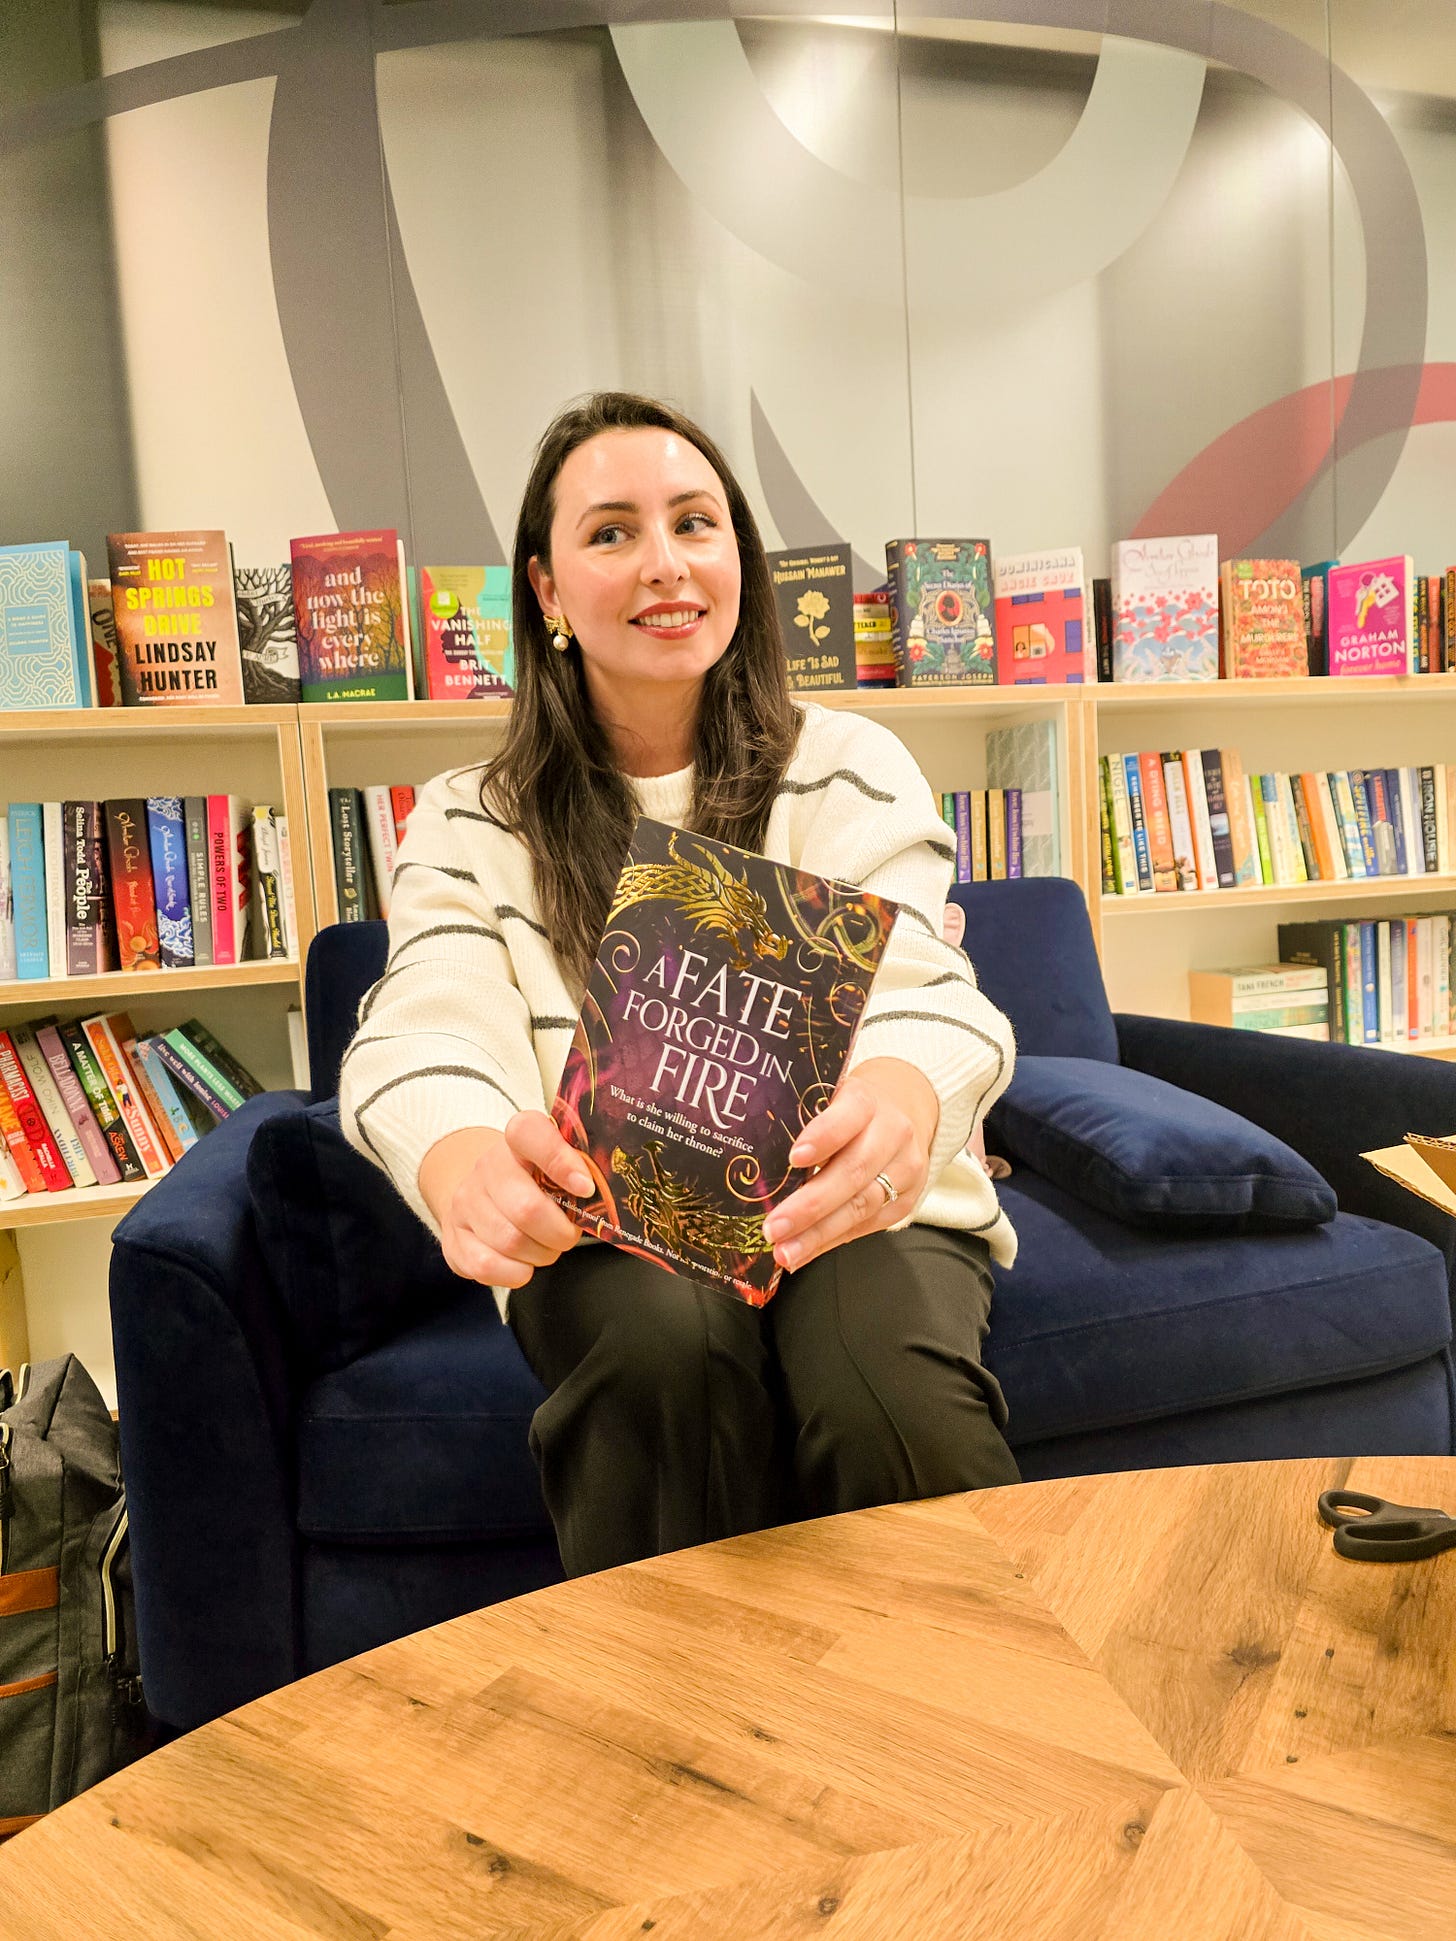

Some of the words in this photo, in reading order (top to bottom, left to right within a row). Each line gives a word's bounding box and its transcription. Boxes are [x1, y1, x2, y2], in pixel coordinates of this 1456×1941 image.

[147, 558, 185, 580] HOT
[324, 566, 361, 587] and
[773, 569, 806, 584] HUSSAIN
[806, 564, 846, 579] MANAWER
[125, 585, 215, 610] SPRINGS
[307, 593, 343, 610] now
[351, 586, 385, 606] the
[143, 613, 202, 637] DRIVE
[312, 609, 358, 634] light
[364, 608, 381, 625] is
[431, 618, 513, 632] VANISHING
[135, 641, 216, 664] LINDSAY
[321, 632, 372, 652] every
[454, 634, 492, 646] HALF
[1335, 640, 1406, 663] NORTON
[1340, 629, 1399, 648] GRAHAM
[318, 650, 380, 669] where
[460, 659, 490, 671] BRIT
[787, 659, 806, 672] LIFE
[821, 654, 839, 669] SAD
[140, 669, 217, 692] HUNTER
[342, 688, 376, 699] MACRAE
[444, 674, 507, 687] BENNETT
[796, 672, 844, 687] BEAUTIFUL
[1147, 759, 1157, 768] A
[1111, 761, 1126, 806] NIGEL
[1149, 770, 1162, 807] DYING
[1422, 780, 1434, 813] IRON
[75, 807, 85, 838] Selina
[340, 805, 351, 828] Lost
[380, 813, 392, 848] PERFECT
[1154, 810, 1167, 845] BREED
[15, 818, 34, 871] LEIGH
[1423, 814, 1437, 861] HOUSE
[76, 840, 87, 864] Todd
[213, 832, 226, 873] POWERS
[342, 831, 357, 884] Storyteller
[196, 852, 206, 888] SIMPLE
[215, 877, 227, 888] OF
[73, 867, 92, 920] People
[199, 891, 208, 923] RULES
[217, 891, 227, 912] TWO
[20, 876, 39, 949] FERMOR
[643, 955, 666, 989] A
[669, 949, 802, 1040] FATE
[622, 989, 760, 1066] FORGED
[760, 1052, 793, 1084] IN
[0, 1049, 30, 1102] PHARMACIST
[27, 1054, 48, 1084] WOLF
[49, 1052, 86, 1113] BELLADONNA
[72, 1042, 82, 1051] A
[77, 1050, 98, 1090] MATTER
[92, 1086, 104, 1101] OF
[98, 1100, 114, 1124] TIME
[169, 1055, 183, 1070] well
[181, 1068, 195, 1083] with
[649, 1042, 758, 1129] FIRE
[45, 1088, 60, 1115] NIKO
[127, 1105, 152, 1151] Sunny
[610, 1085, 635, 1105] What
[636, 1097, 645, 1109] is
[646, 1103, 663, 1117] she
[664, 1111, 699, 1134] willing
[700, 1125, 711, 1136] to
[712, 1131, 754, 1153] sacrifice
[109, 1131, 128, 1161] ASKEW
[626, 1112, 637, 1122] to
[638, 1117, 665, 1135] claim
[666, 1127, 684, 1143] her
[685, 1135, 724, 1159] throne?
[582, 1210, 600, 1223] proof
[600, 1216, 614, 1230] from
[614, 1224, 643, 1244] Renegade
[643, 1238, 665, 1254] Books.
[723, 1274, 733, 1283] or
